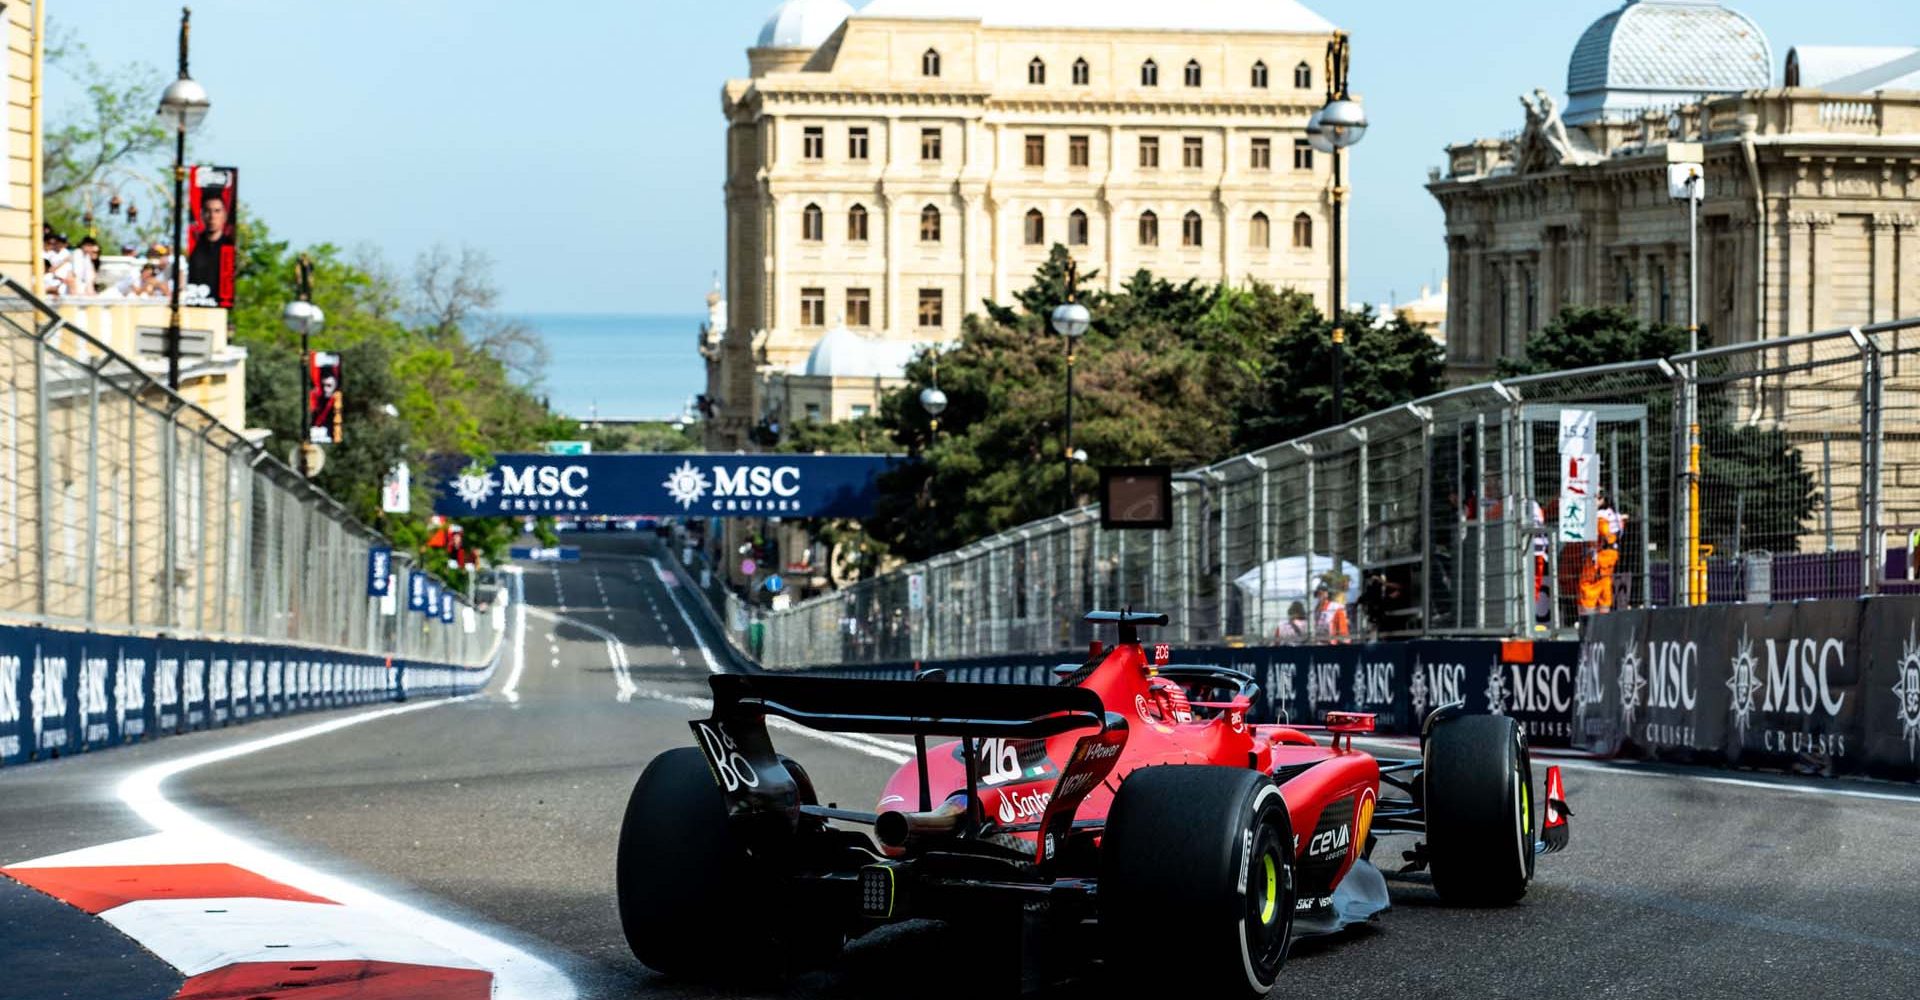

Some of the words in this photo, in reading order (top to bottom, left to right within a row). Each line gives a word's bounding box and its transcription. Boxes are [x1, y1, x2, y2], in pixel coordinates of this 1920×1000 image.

[500, 465, 589, 497] MSC
[712, 466, 800, 497] MSC
[711, 500, 800, 511] CRUISES
[1366, 662, 1395, 705] MSC
[1428, 663, 1467, 707] MSC
[1511, 664, 1572, 713] MSC
[1648, 641, 1697, 710] MSC
[1763, 637, 1845, 716] MSC
[981, 738, 1022, 786] 16
[1083, 742, 1120, 761] V-Power
[1764, 729, 1845, 758] CRUISES
